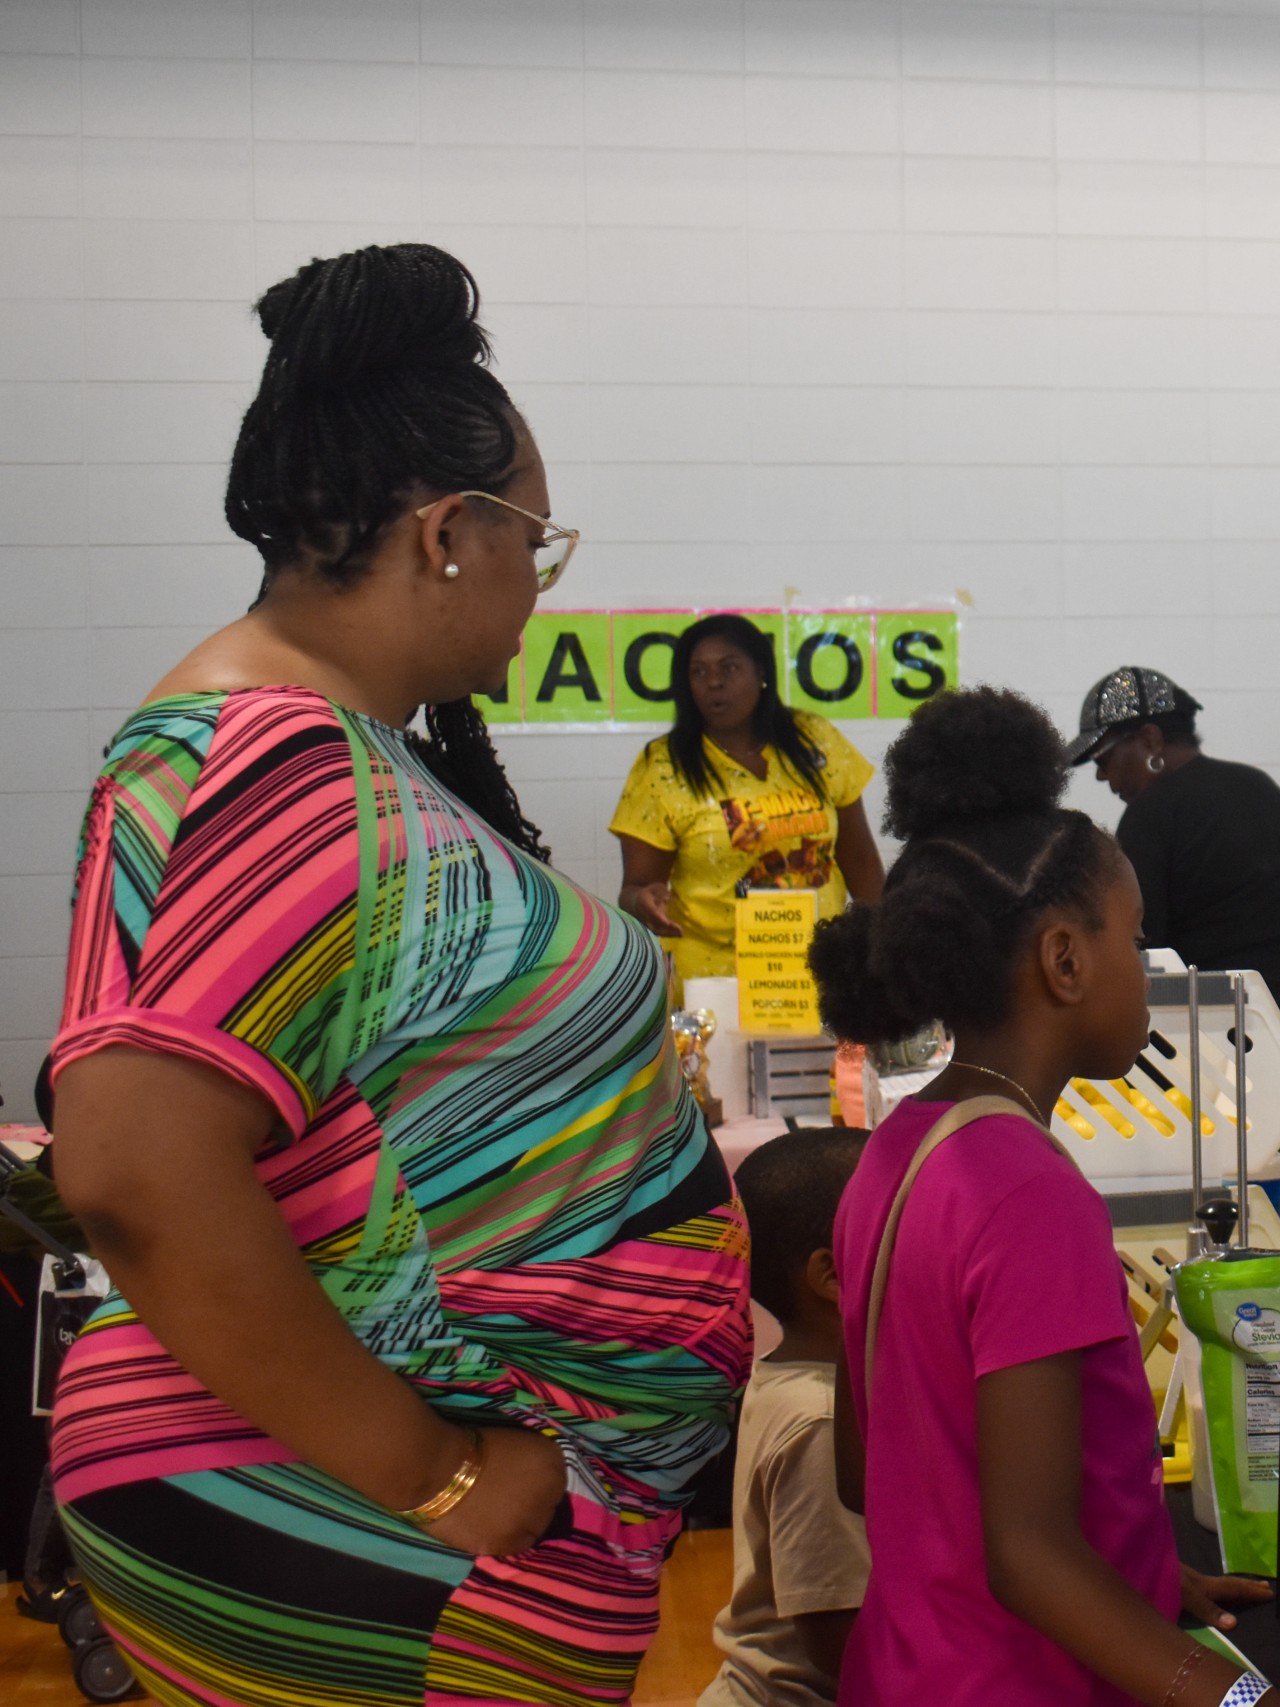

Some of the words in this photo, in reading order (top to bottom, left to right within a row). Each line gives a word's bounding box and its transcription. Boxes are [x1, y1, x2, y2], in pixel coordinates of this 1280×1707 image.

[480, 631, 947, 704] ACOS
[754, 910, 802, 922] NACHOS
[748, 933, 791, 944] NACHOS
[792, 933, 804, 944] $7
[767, 962, 783, 972] $10
[748, 980, 798, 989] LEMONADE
[752, 999, 797, 1009] POPCORN
[1251, 1332, 1280, 1342] Stevia
[1247, 1388, 1276, 1396] Calories
